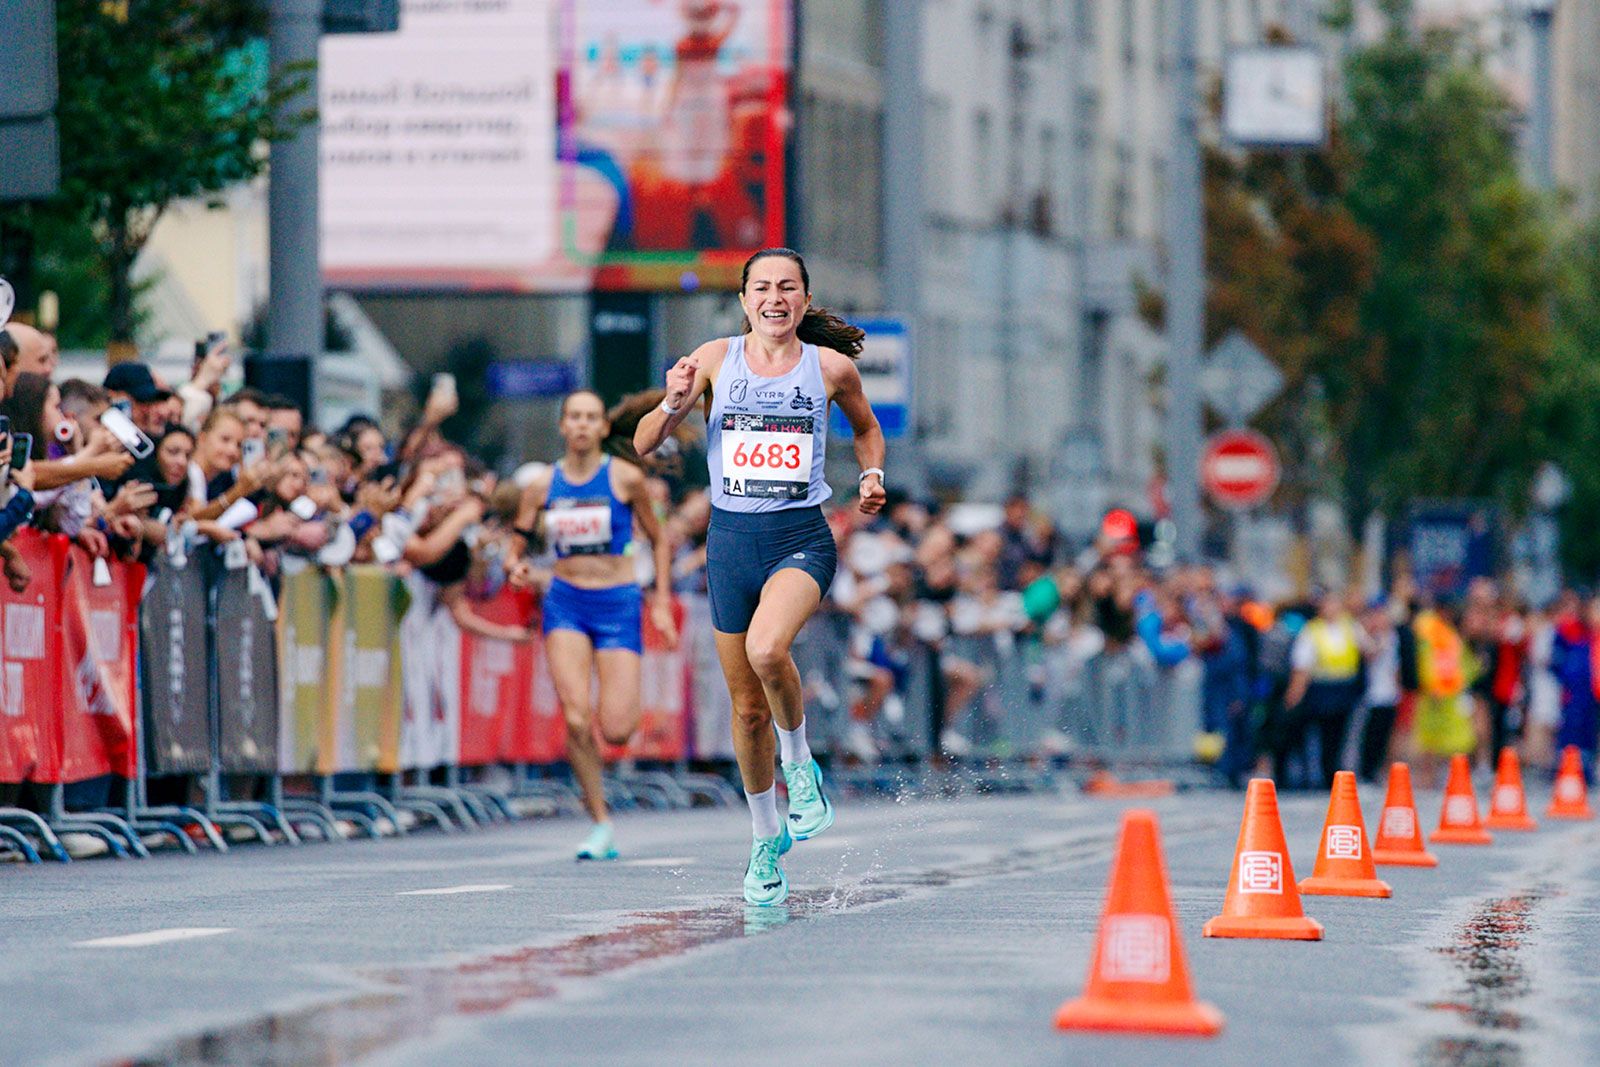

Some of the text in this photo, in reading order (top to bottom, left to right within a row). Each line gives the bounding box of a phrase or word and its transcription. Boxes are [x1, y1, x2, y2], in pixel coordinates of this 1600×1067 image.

[781, 425, 802, 433] KM
[733, 442, 800, 469] 6683
[732, 479, 743, 493] A
